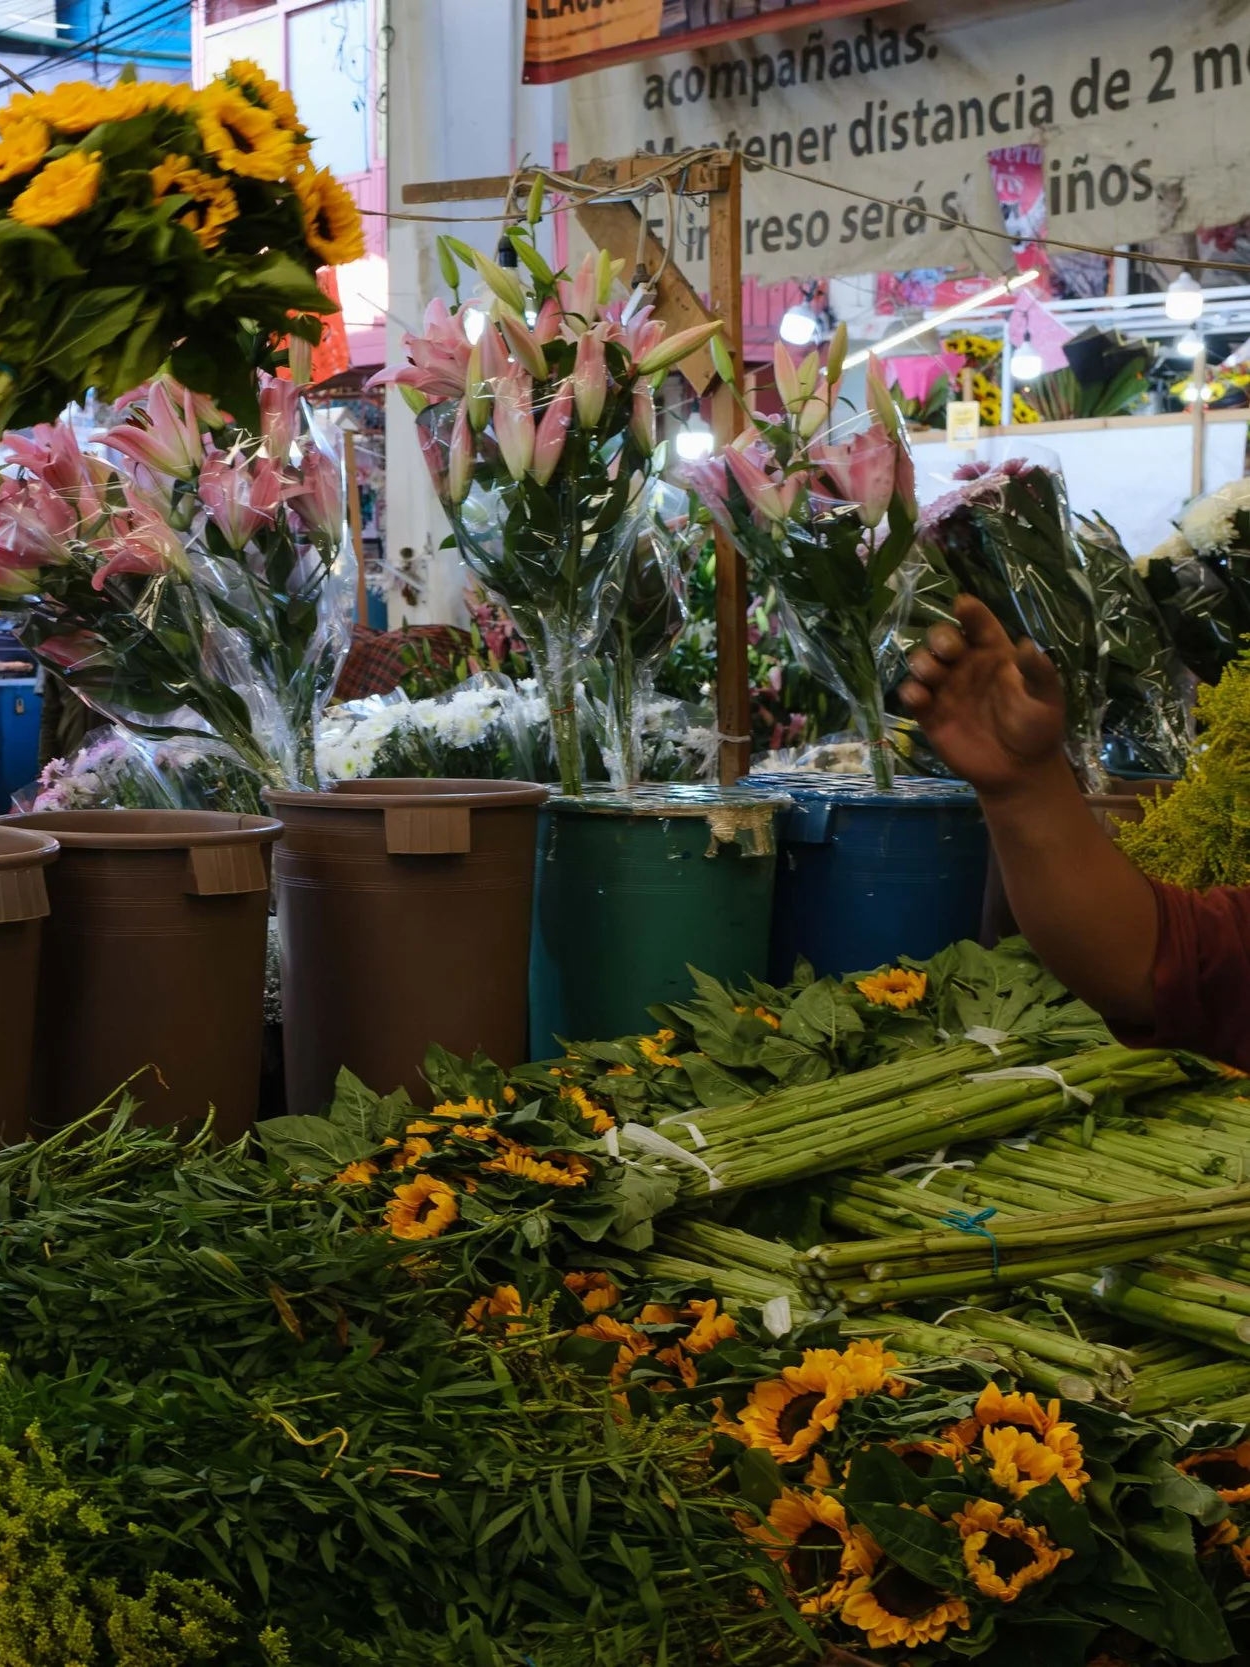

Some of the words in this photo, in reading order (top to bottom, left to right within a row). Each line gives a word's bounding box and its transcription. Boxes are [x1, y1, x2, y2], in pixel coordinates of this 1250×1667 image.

[643, 17, 938, 111] acompañadas.
[850, 73, 1054, 157] distancia
[1070, 56, 1130, 119] de
[1147, 45, 1176, 104] 2
[1193, 43, 1250, 93] m
[839, 180, 928, 244] será
[1050, 154, 1154, 216] iños
